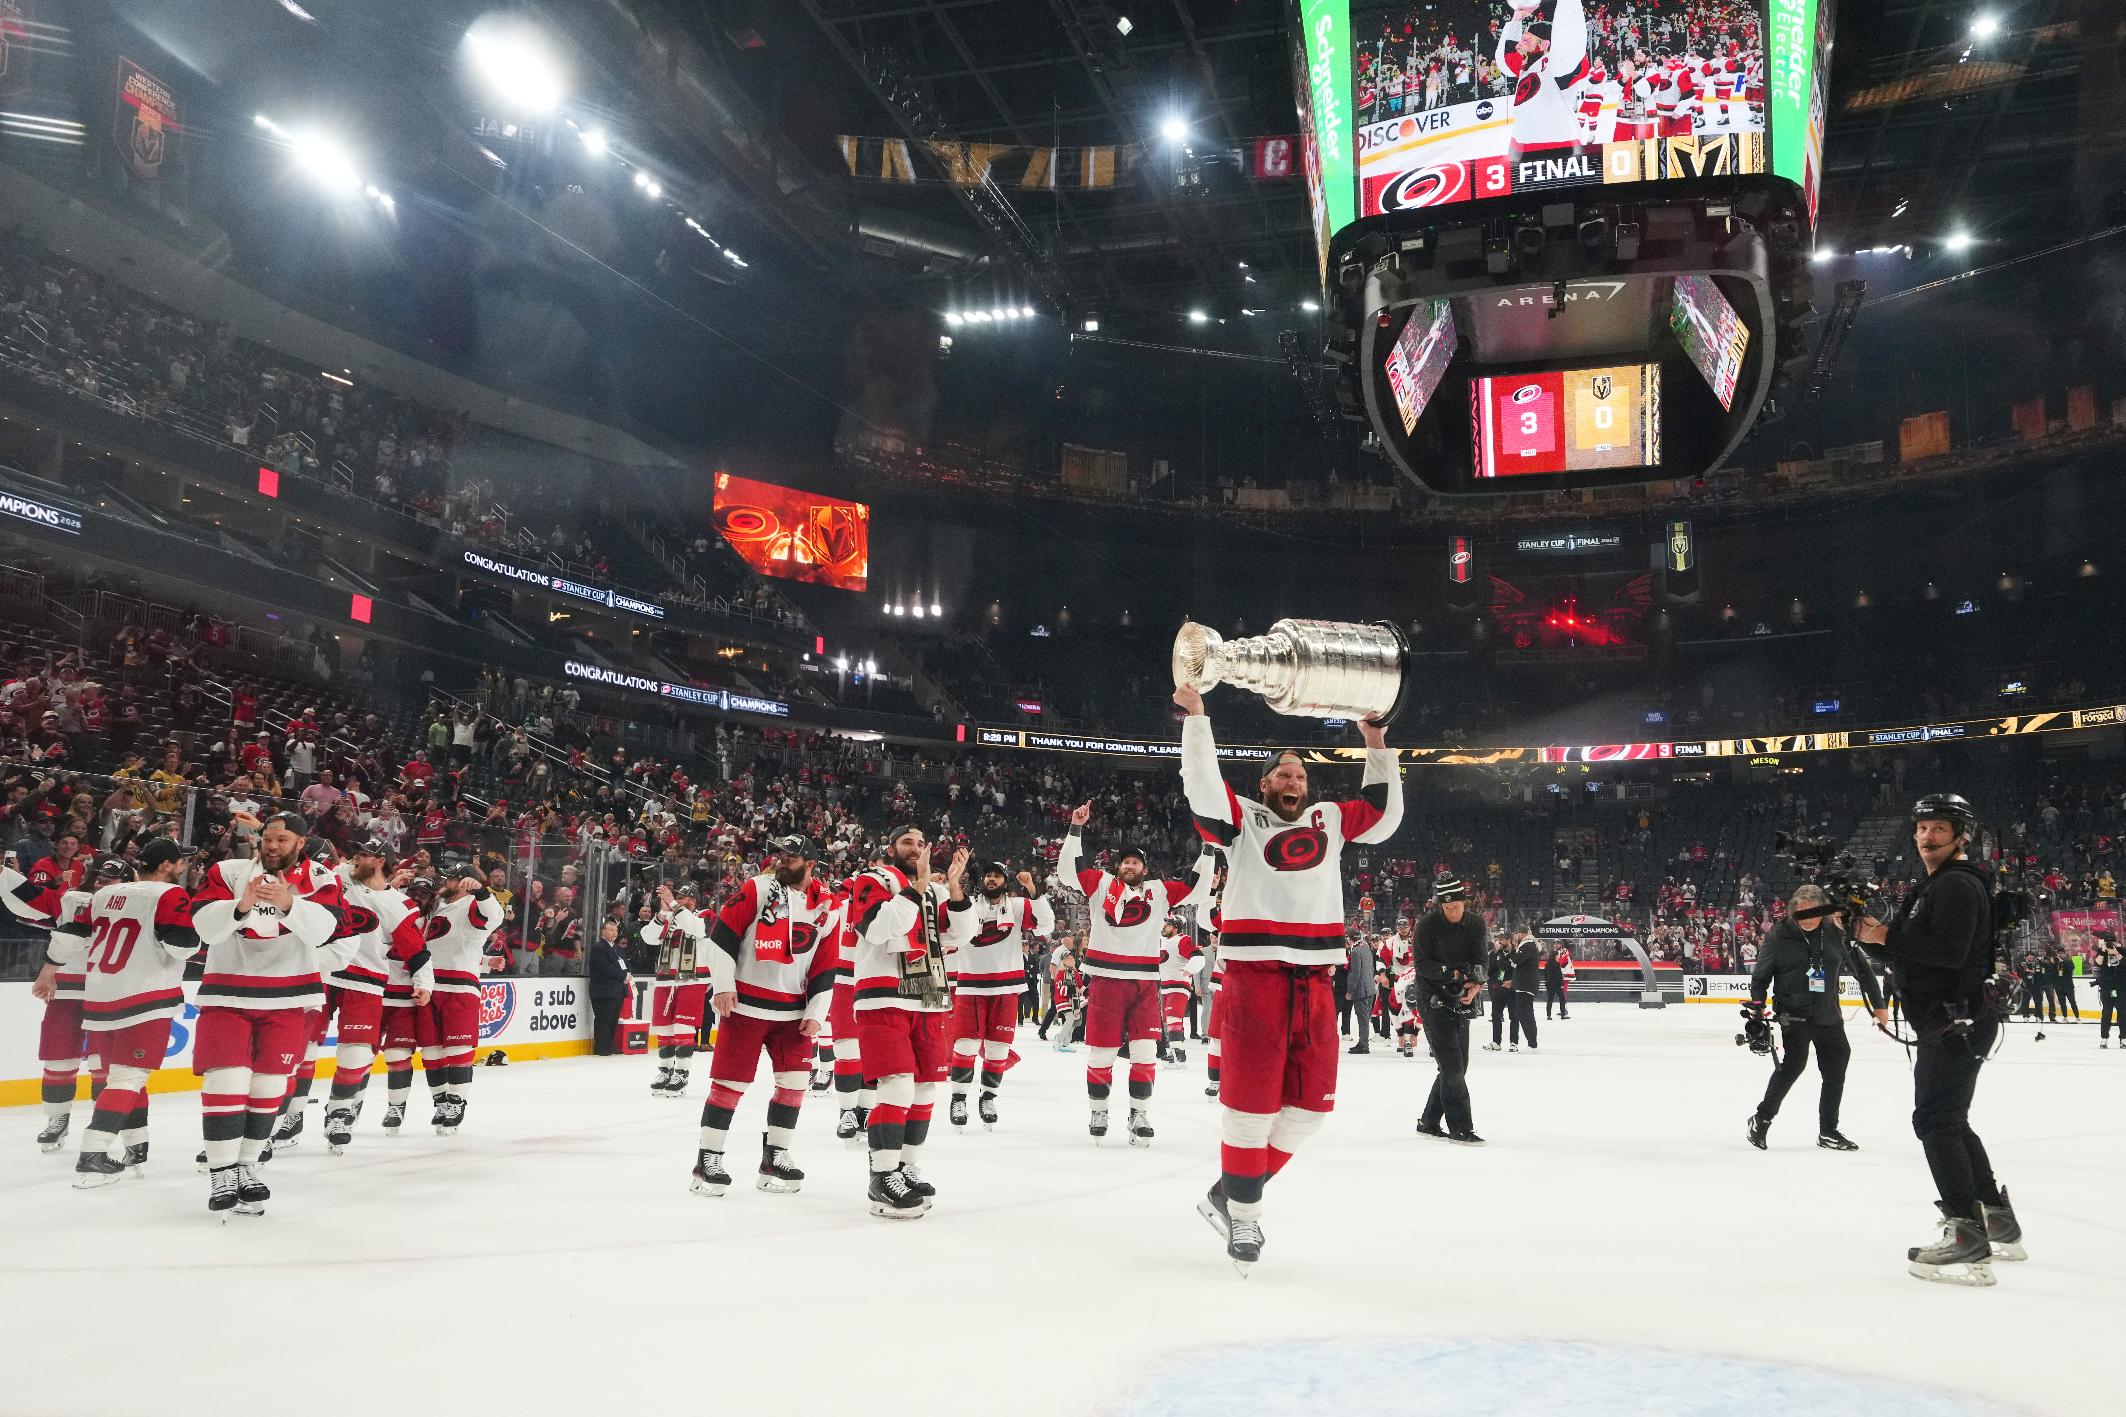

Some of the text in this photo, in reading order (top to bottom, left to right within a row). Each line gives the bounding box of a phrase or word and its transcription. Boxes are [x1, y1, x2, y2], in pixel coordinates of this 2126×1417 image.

[1773, 12, 1791, 99] Electric
[1787, 0, 1807, 109] neider
[1315, 14, 1343, 161] Schneider
[1486, 150, 1631, 190] 3 FINAL 0
[1498, 290, 1600, 307] ARENA
[1520, 406, 1613, 435] 3 0
[1517, 540, 1549, 549] STANLEY
[1550, 539, 1565, 547] CUP
[1577, 538, 1600, 546] FINAL
[464, 552, 549, 586] CONGRATULATIONS
[562, 582, 592, 597] STANLEY
[592, 590, 605, 601] CUP
[615, 596, 655, 615] CHAMPIONS
[564, 660, 658, 692] CONGRATULATIONS
[671, 686, 702, 701] STANLEY
[702, 692, 718, 703] CUP
[731, 697, 777, 713] CHAMPIONS
[2082, 710, 2114, 723] Forged
[1003, 734, 1016, 743] PM
[1875, 732, 1906, 741] STANLEY
[1907, 731, 1920, 739] CUP
[1931, 727, 1953, 737] FINAL
[1030, 736, 1063, 747] THANK
[1065, 739, 1084, 748] YOU
[1085, 741, 1104, 750] FOR
[1105, 743, 1147, 754] COMING,
[1149, 745, 1182, 754] PLEASE
[1660, 745, 1670, 757] 3
[1675, 744, 1704, 754] FINAL
[1311, 809, 1325, 830] C
[34, 872, 47, 882] 20
[105, 895, 127, 910] AHO
[1144, 889, 1153, 900] A
[87, 917, 142, 974] 20
[755, 939, 782, 949] RMOR
[534, 985, 576, 1006] a sub
[529, 1010, 577, 1031] above
